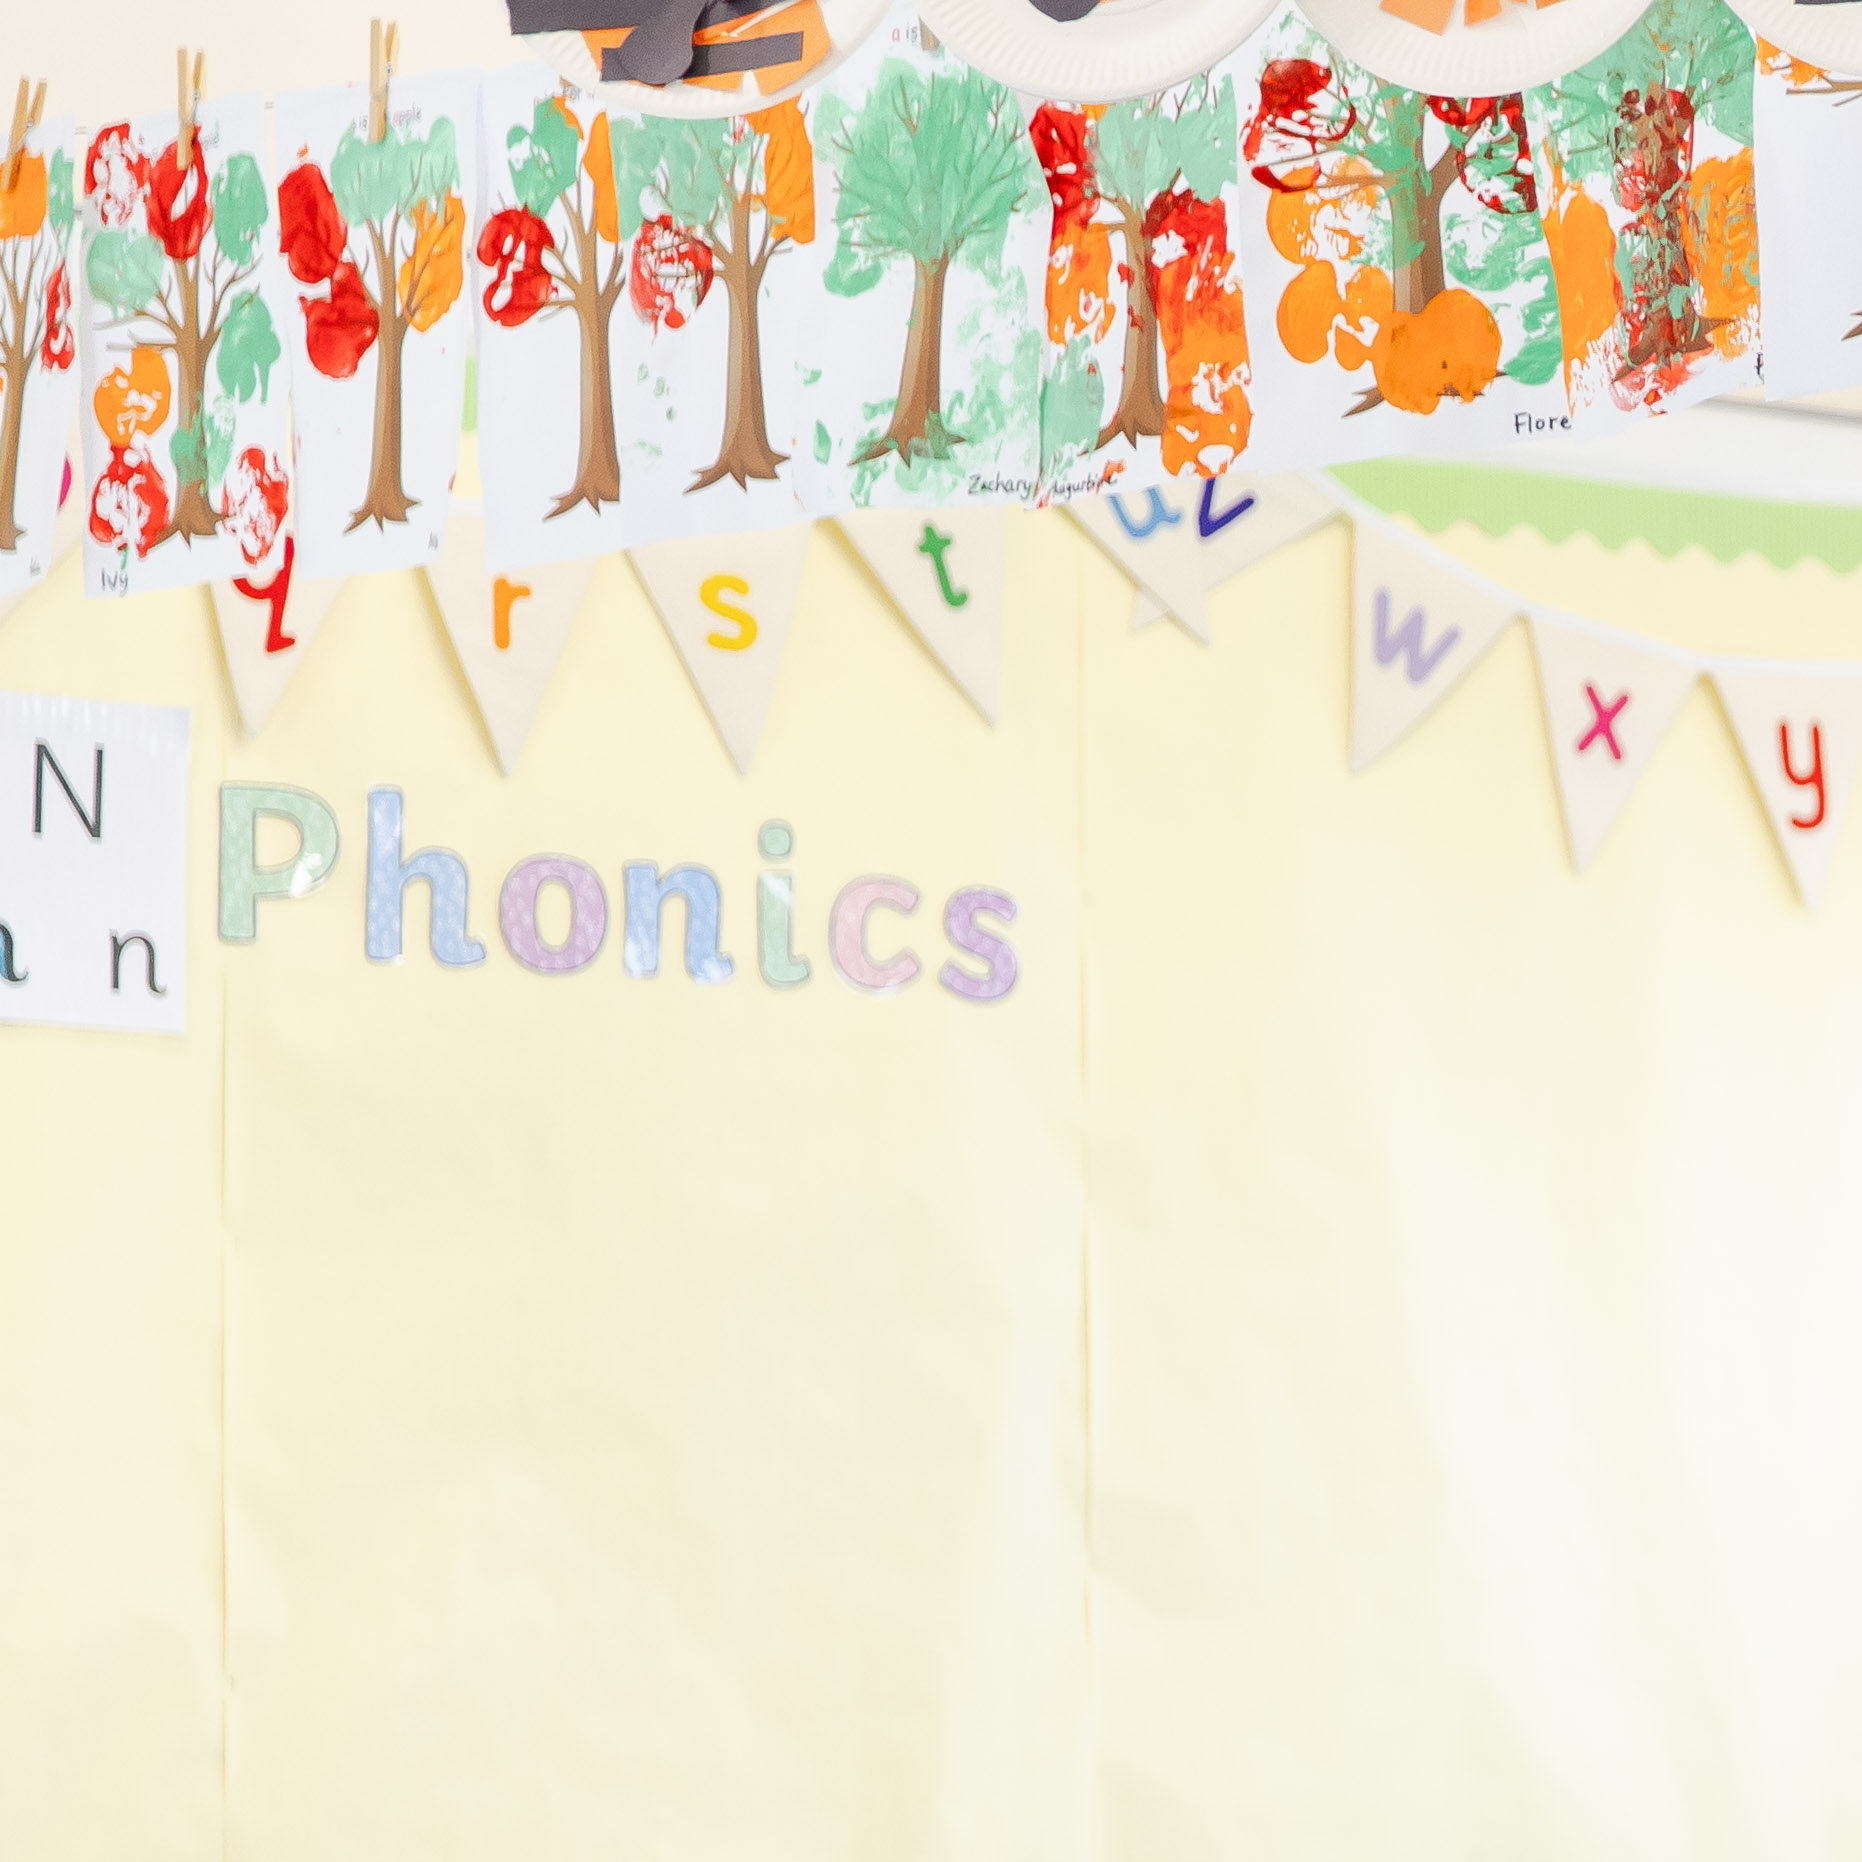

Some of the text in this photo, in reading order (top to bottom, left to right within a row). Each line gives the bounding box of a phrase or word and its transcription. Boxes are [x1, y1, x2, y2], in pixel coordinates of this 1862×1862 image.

[1514, 411, 1572, 434] Flore
[967, 472, 1031, 500] Zachary
[492, 575, 532, 651] r
[699, 574, 760, 651] s
[917, 526, 970, 607] t
[1373, 588, 1461, 683] w
[1576, 682, 1629, 760] x
[1779, 721, 1826, 829] y
[217, 779, 1022, 1002] Phonics
